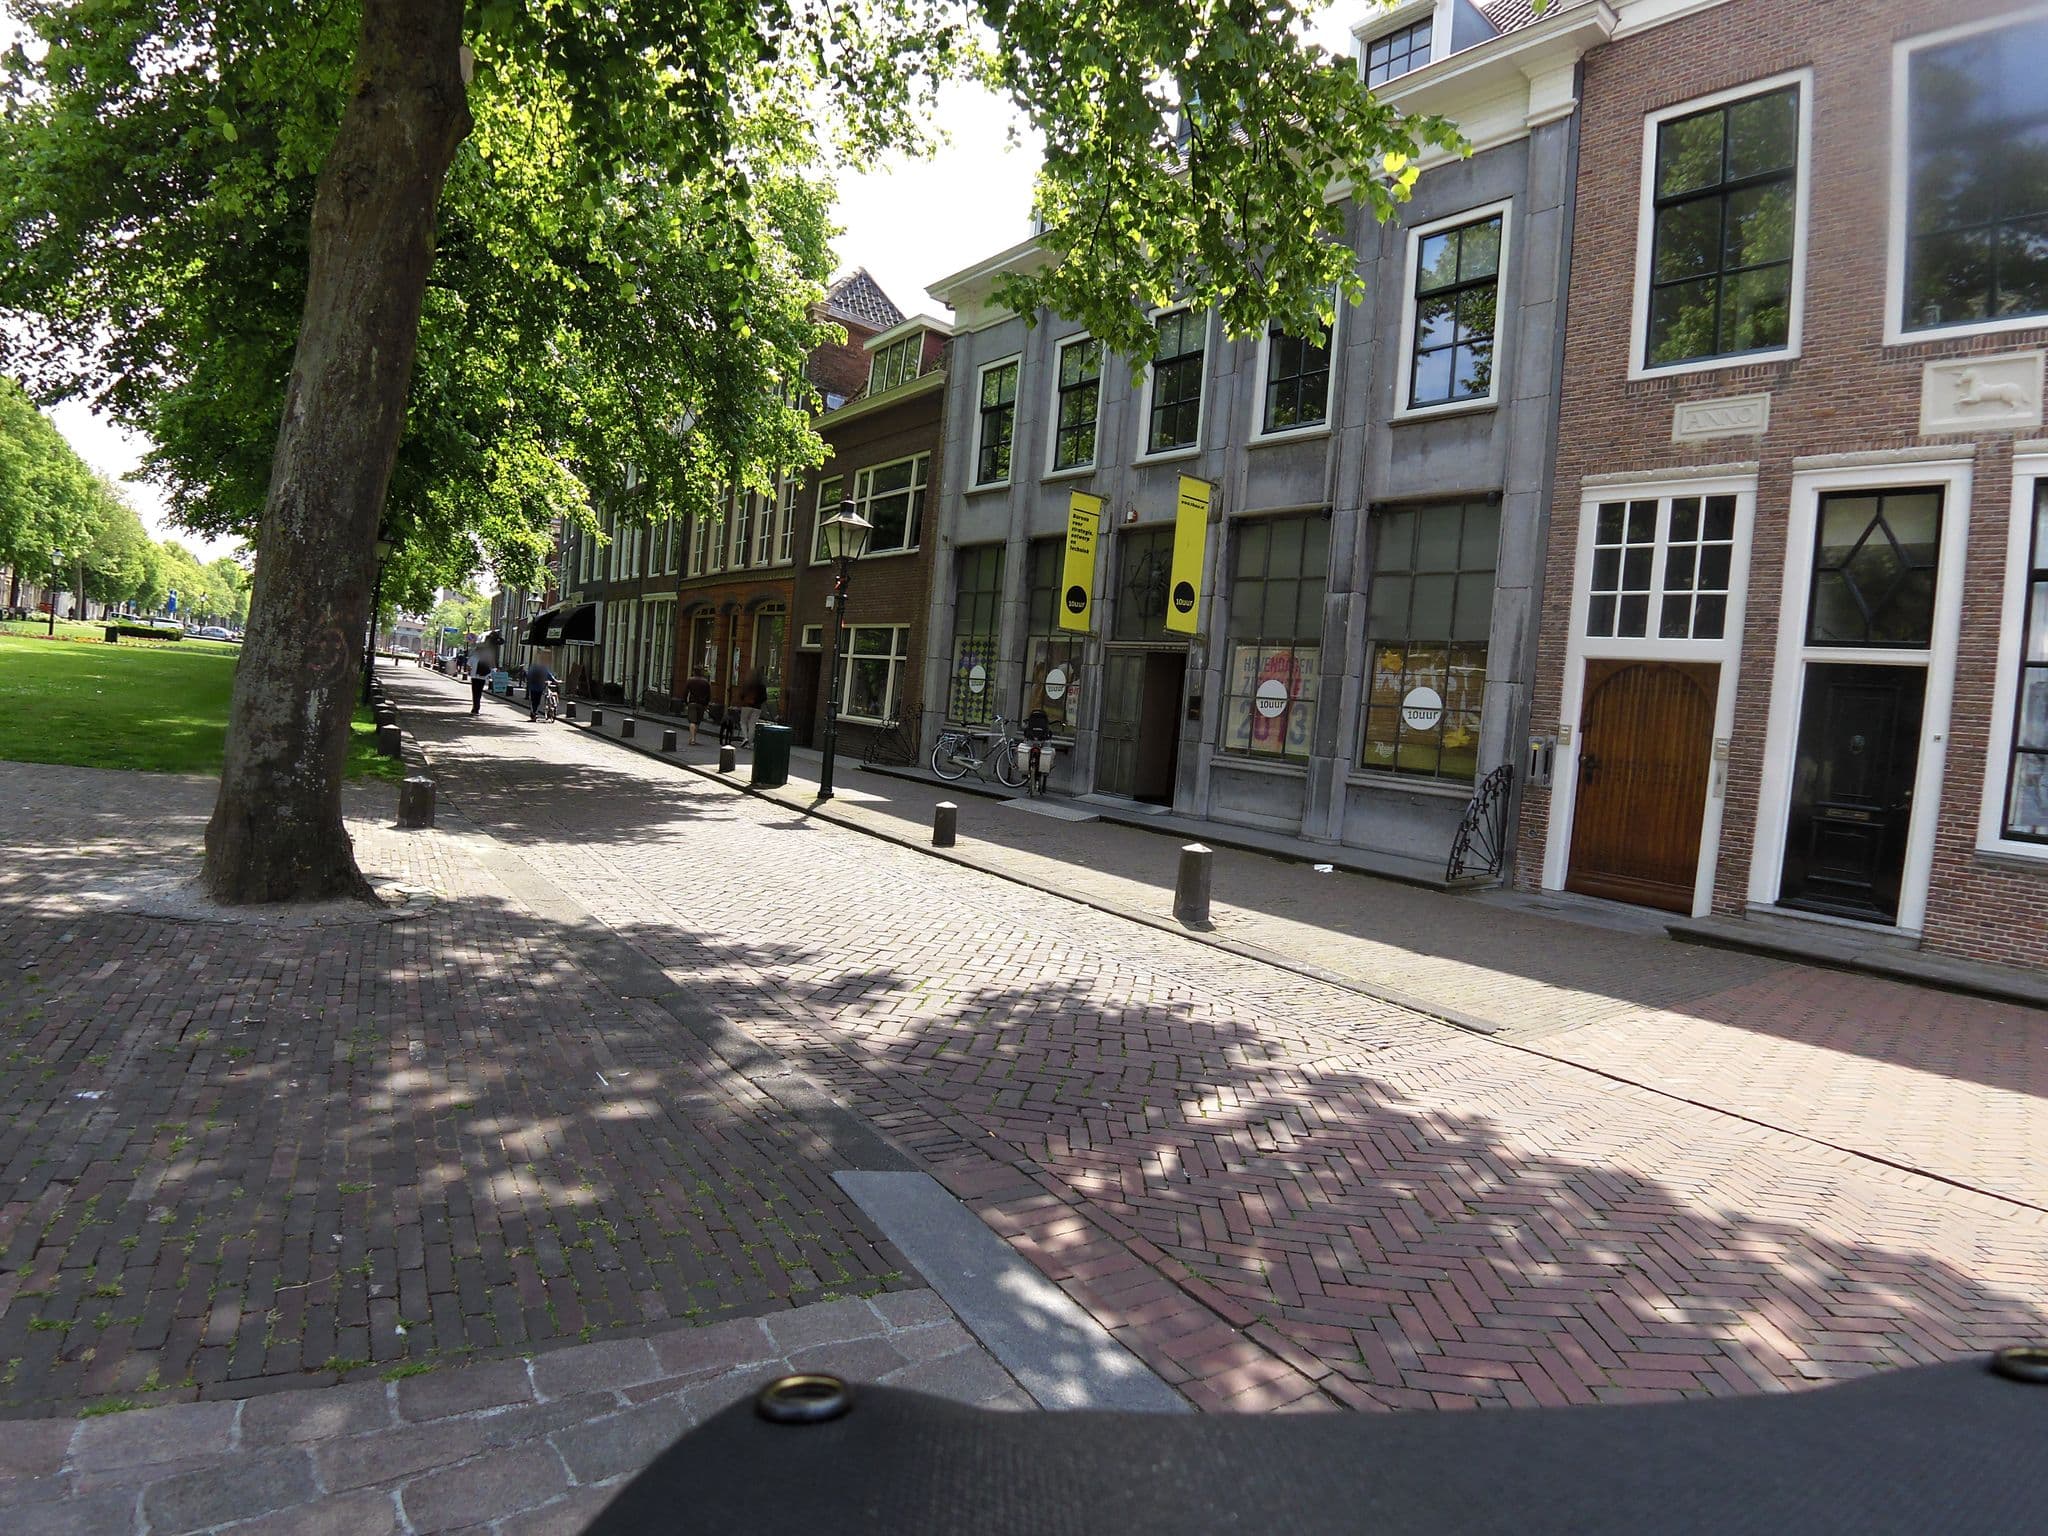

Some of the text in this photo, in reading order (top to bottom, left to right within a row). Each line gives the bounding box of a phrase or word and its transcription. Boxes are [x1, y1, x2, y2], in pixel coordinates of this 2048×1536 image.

[1685, 407, 1753, 429] ANNO
[1068, 600, 1085, 608] 10uur
[1176, 598, 1193, 606] 10uur
[1260, 700, 1285, 709] 10uur
[1407, 710, 1438, 720] 10uur
